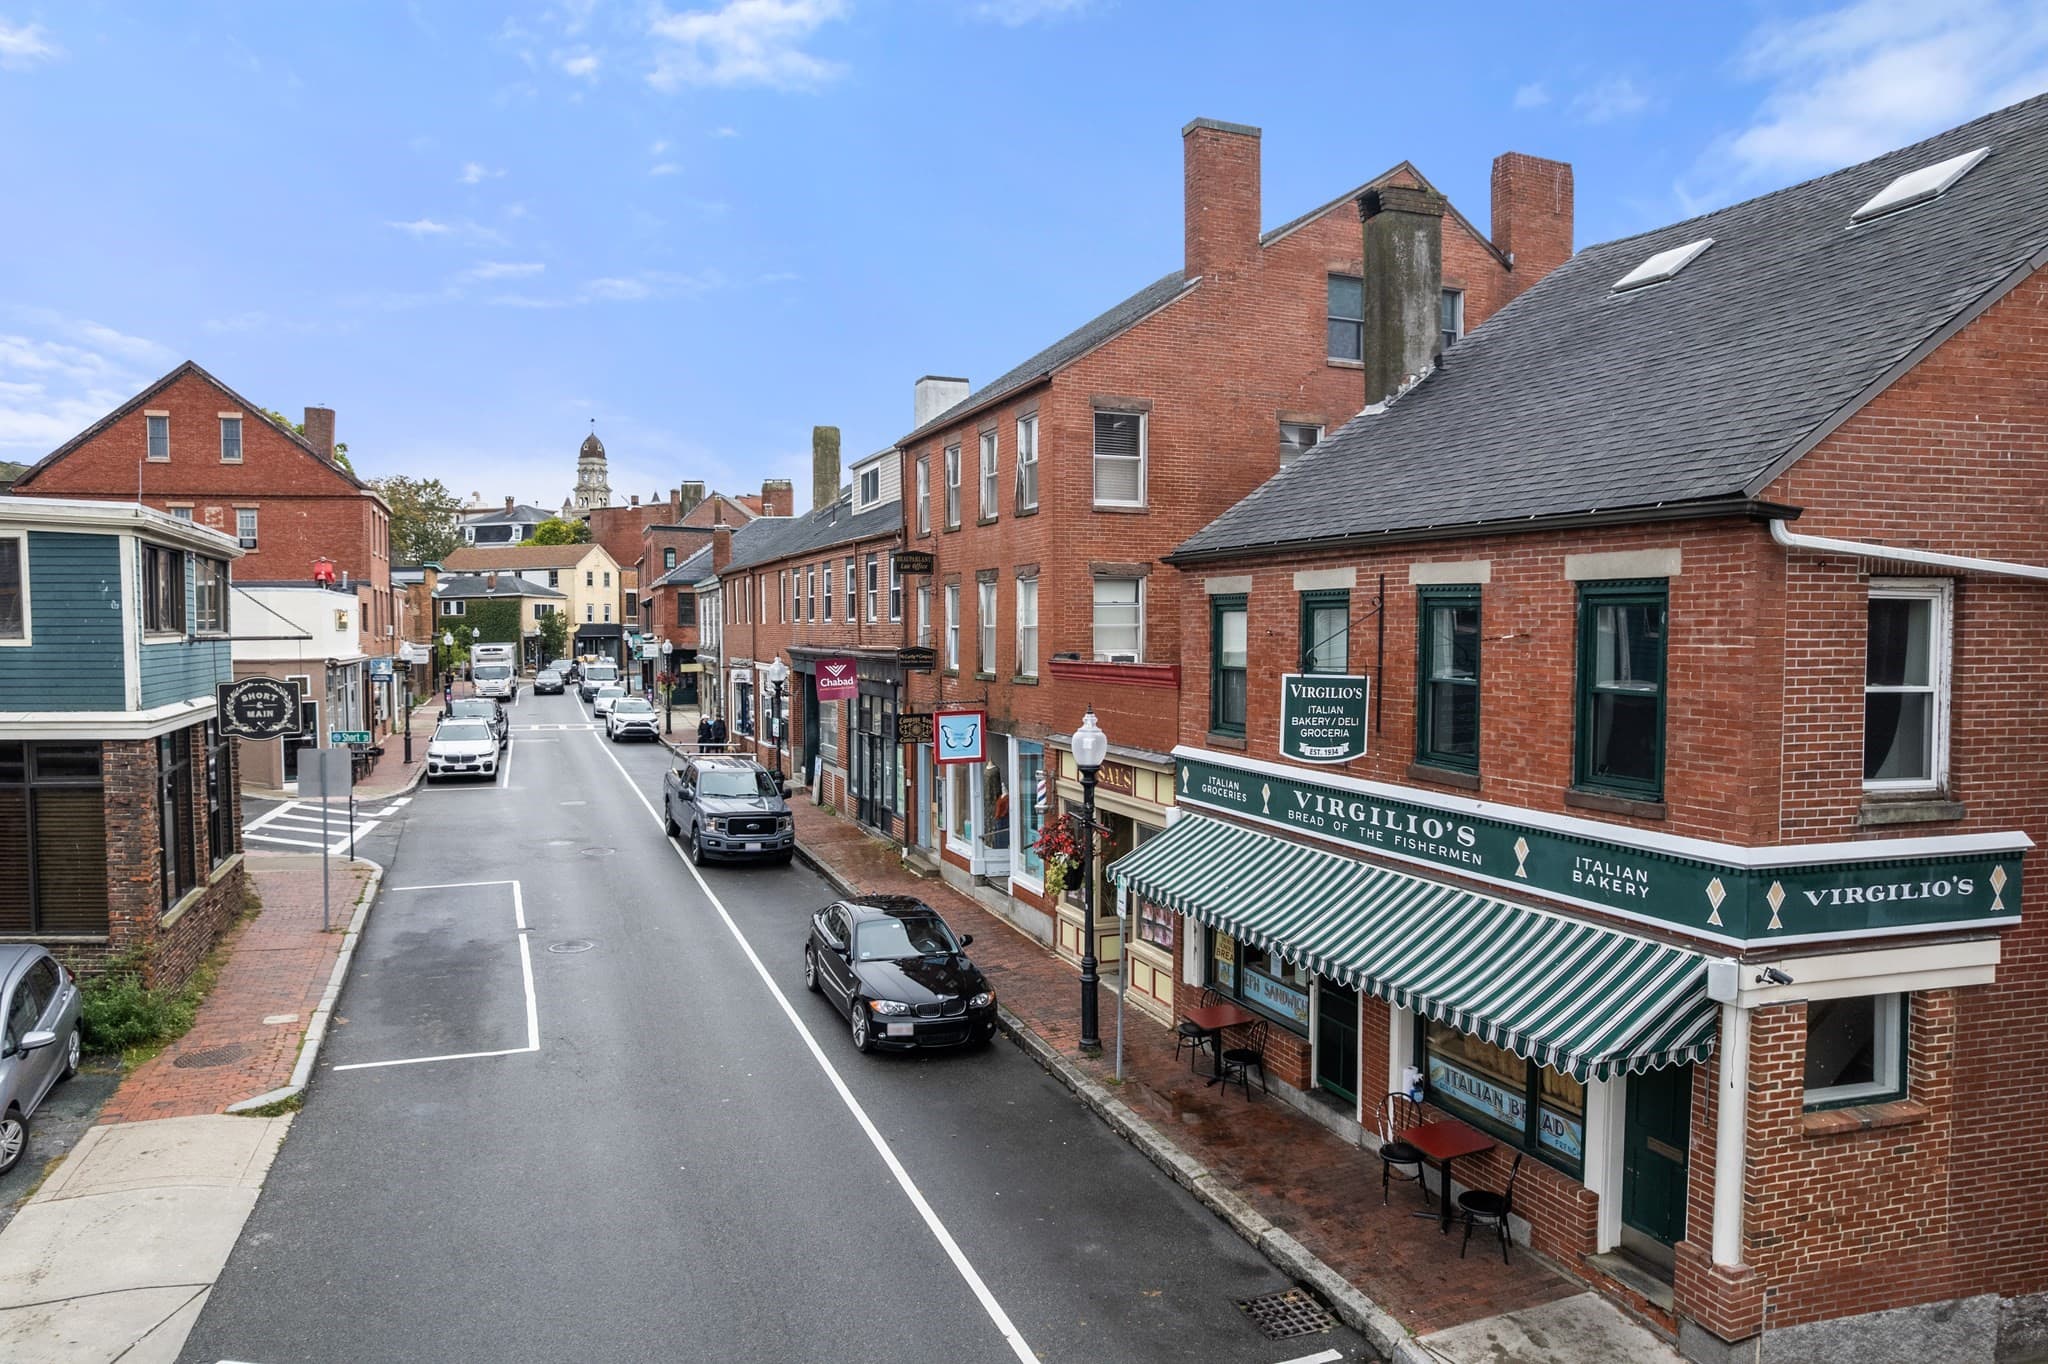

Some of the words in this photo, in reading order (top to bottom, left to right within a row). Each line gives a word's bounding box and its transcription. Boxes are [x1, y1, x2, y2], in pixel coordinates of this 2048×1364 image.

[820, 677, 854, 687] Chabad
[241, 692, 278, 702] SHORT
[1290, 684, 1363, 699] VIRGILIO'S
[246, 710, 274, 718] MAIN
[1308, 705, 1344, 714] ITALIAN
[342, 731, 360, 742] Short
[1300, 728, 1350, 737] GROCERIA
[1097, 765, 1131, 788] SAL'S
[1208, 776, 1240, 790] ITALIAN
[1201, 784, 1247, 802] GROCERIES
[1293, 790, 1476, 847] VIRGILIO'S
[1288, 809, 1325, 827] BREAD
[1333, 820, 1349, 832] OF
[1359, 827, 1384, 841] THE
[1394, 836, 1482, 865] FISHERMEN
[1576, 856, 1648, 883] ITALIAN
[1572, 870, 1649, 898] BAKERY
[1803, 875, 1974, 906] VIRGILIO'S
[1443, 1065, 1504, 1109] ITALIAN
